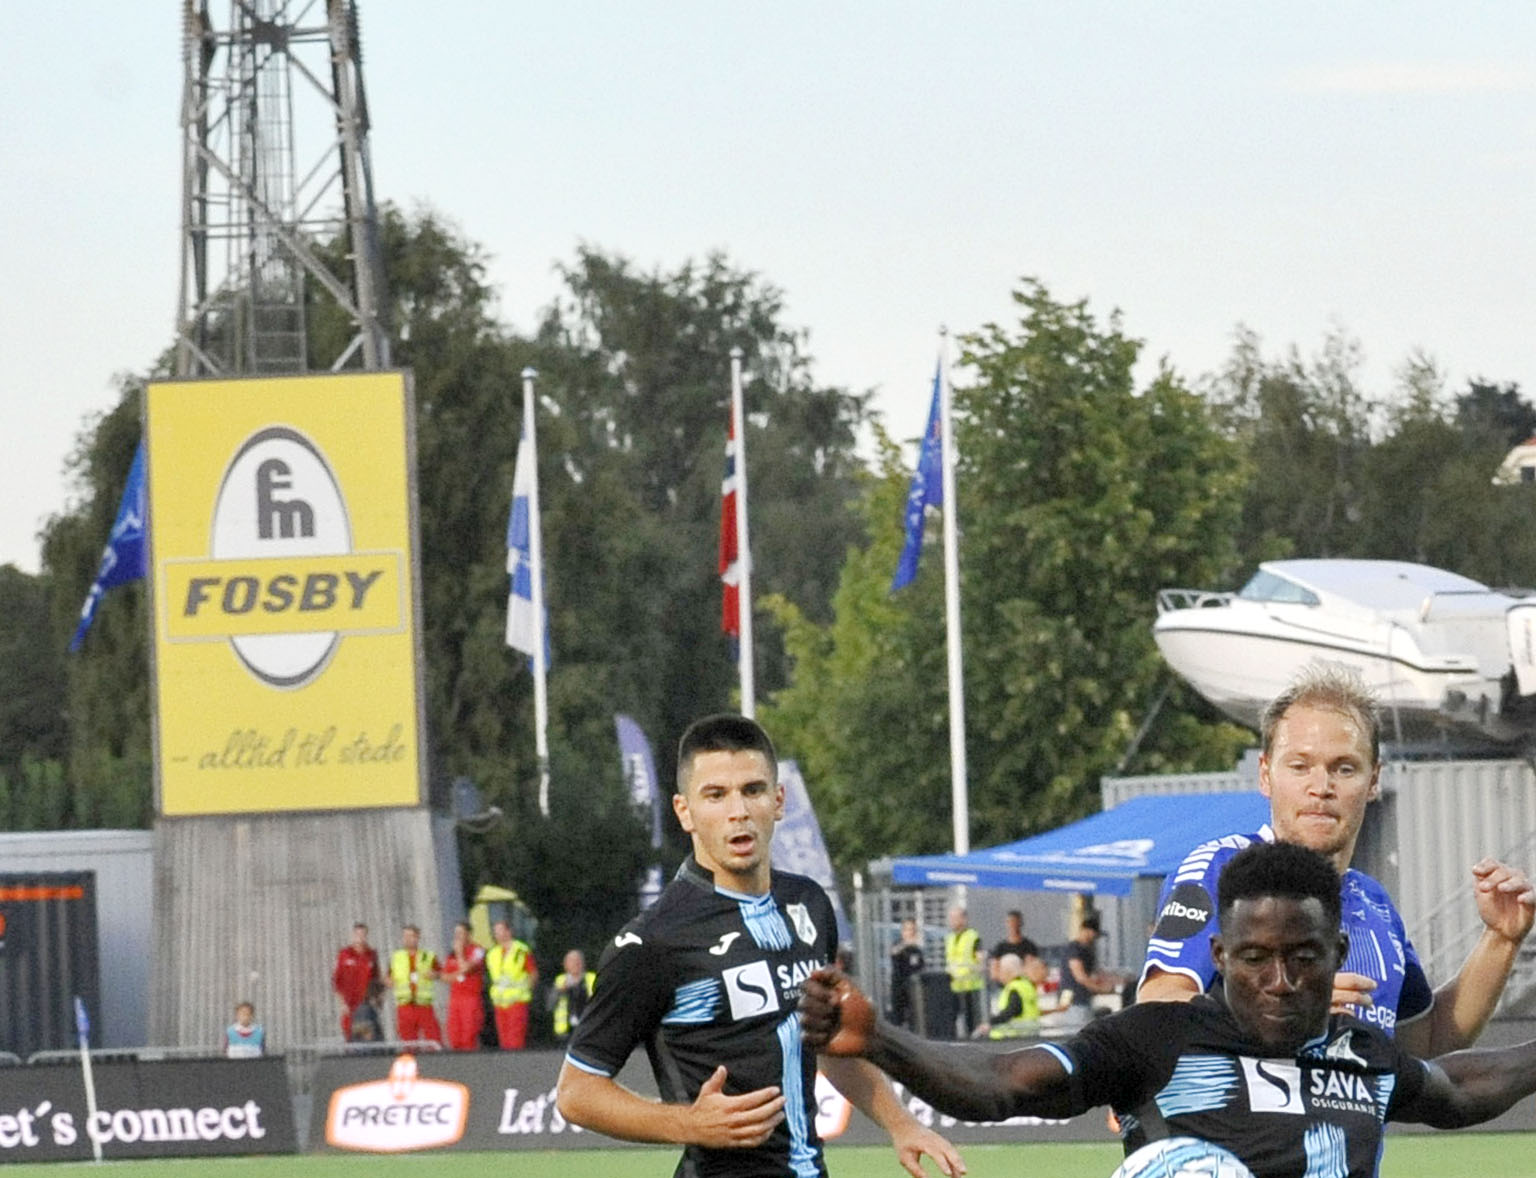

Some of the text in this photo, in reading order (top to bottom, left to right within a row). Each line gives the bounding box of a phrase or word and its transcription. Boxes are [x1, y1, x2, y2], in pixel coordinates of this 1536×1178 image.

[183, 570, 386, 618] FOSBY
[296, 725, 338, 767] til
[337, 723, 406, 764] stede
[1310, 1069, 1374, 1103] SAVA
[87, 1100, 266, 1143] connect
[342, 1099, 452, 1128] PRETEC
